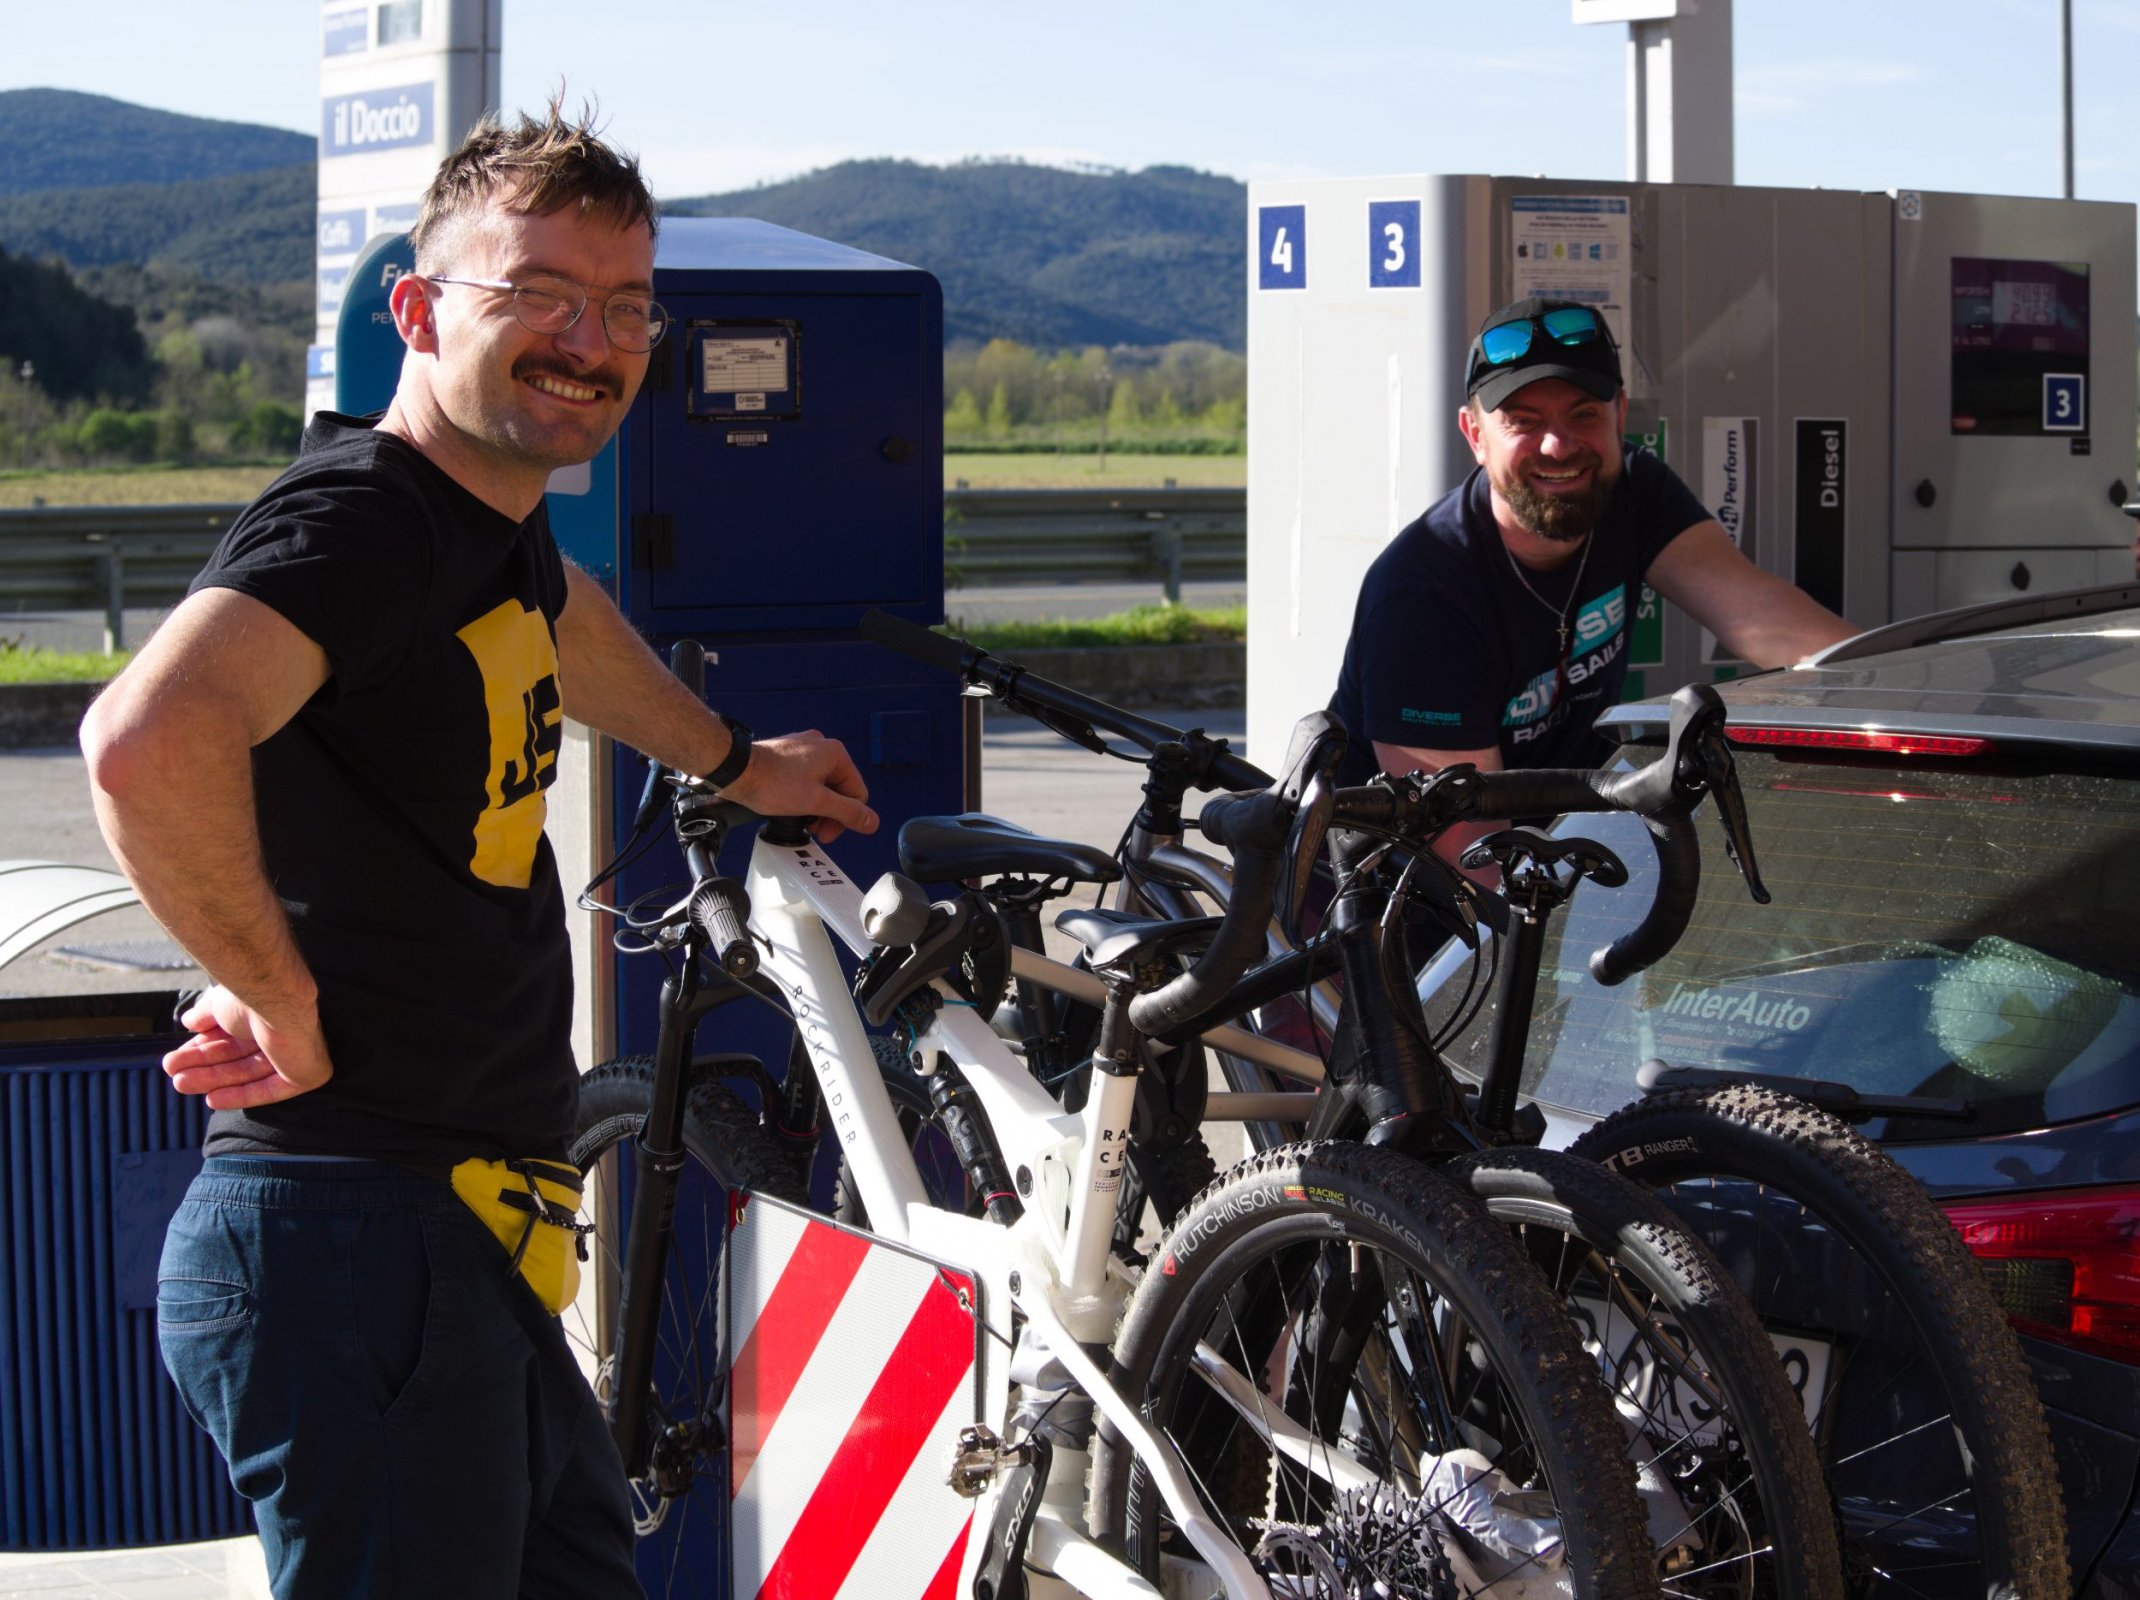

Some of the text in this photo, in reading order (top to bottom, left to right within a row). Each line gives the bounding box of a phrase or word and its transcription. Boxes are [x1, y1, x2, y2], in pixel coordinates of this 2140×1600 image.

[334, 95, 421, 147] il Doccio
[1270, 226, 1293, 274] 4
[1383, 222, 1406, 272] 3
[2054, 387, 2073, 418] 3
[1723, 430, 1738, 504] Perform
[1820, 429, 1841, 509] Diesel
[1566, 631, 1625, 685] SAILS
[1401, 707, 1463, 722] DIVERSE
[1662, 983, 1812, 1032] InterAuto
[792, 983, 859, 1147] ROCKRIDER
[1643, 1137, 1690, 1156] RANGER
[1308, 1186, 1346, 1202] RACING
[1173, 1185, 1433, 1264] HUTCHINSON KRAKEN
[1004, 1475, 1034, 1562] STYLO
